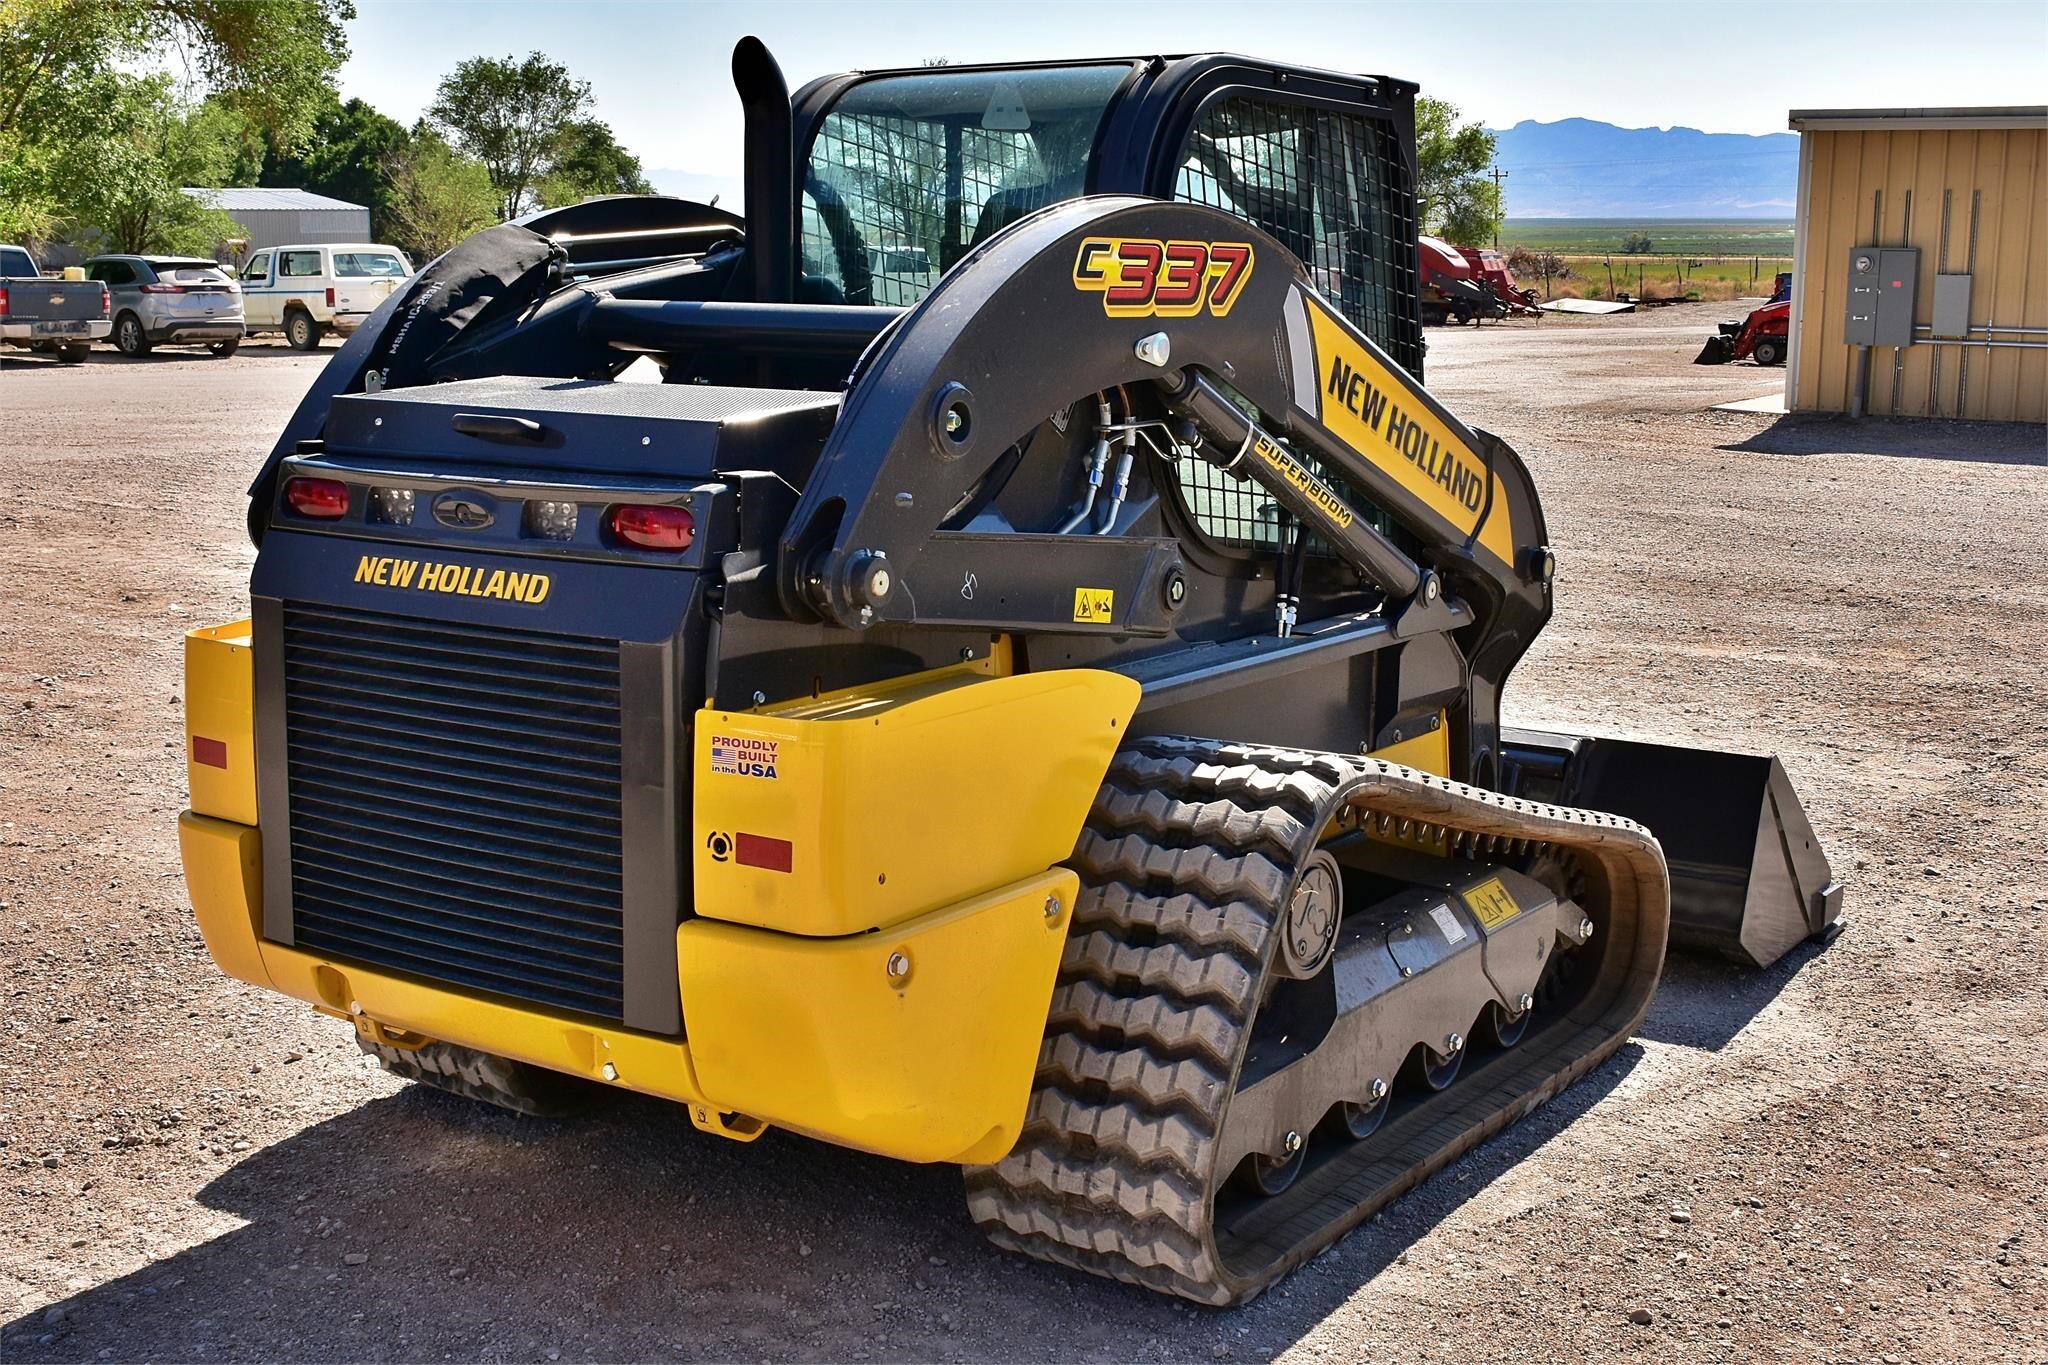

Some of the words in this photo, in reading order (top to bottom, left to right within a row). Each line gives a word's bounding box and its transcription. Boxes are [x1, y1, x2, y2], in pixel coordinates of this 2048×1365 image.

[1074, 238, 1253, 315] C337
[389, 320, 413, 354] MSHA
[1327, 355, 1388, 432] NEW
[1385, 405, 1483, 513] HOLLAND
[354, 556, 419, 588] NEW
[417, 562, 550, 604] HOLLAND
[712, 736, 778, 752] PROUDLY
[738, 750, 778, 763] BUILT
[721, 766, 737, 774] the
[738, 762, 777, 779] USA
